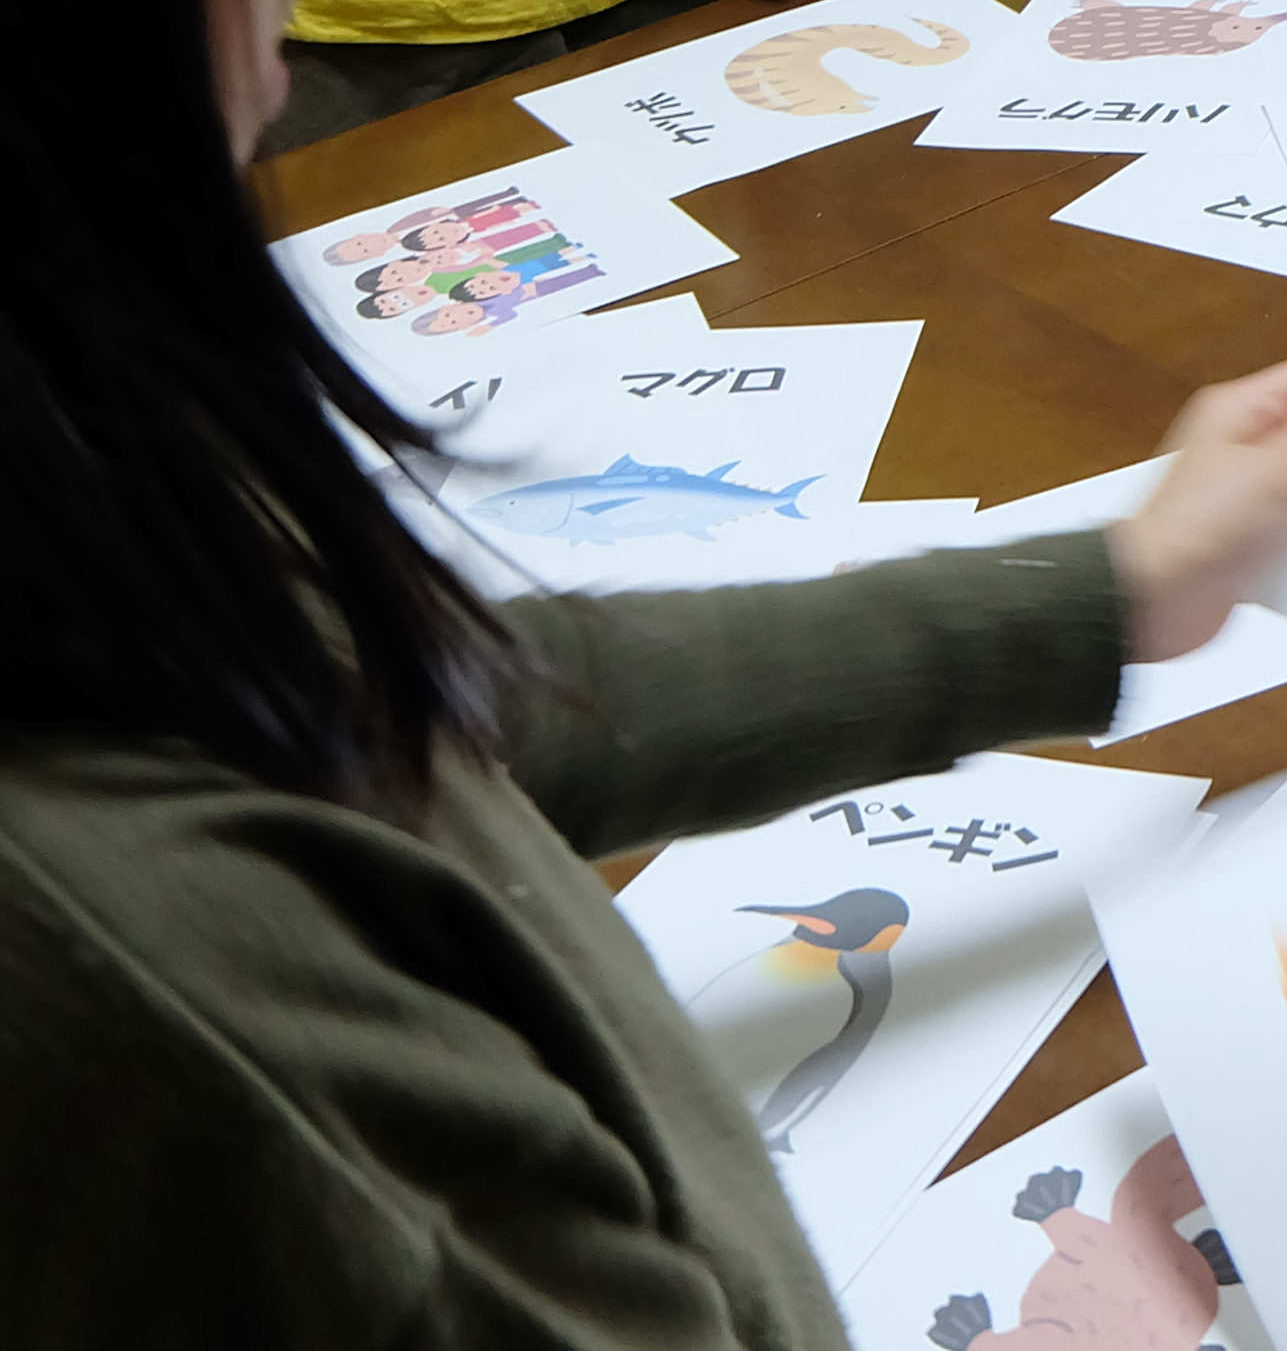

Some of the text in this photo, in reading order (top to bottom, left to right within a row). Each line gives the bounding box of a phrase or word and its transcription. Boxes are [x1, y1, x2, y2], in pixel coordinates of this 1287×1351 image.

[624, 92, 715, 145] ウツボ
[998, 98, 1231, 124] ハリモグラ
[621, 367, 786, 398] マグロ
[810, 800, 1059, 872] ペンギン
